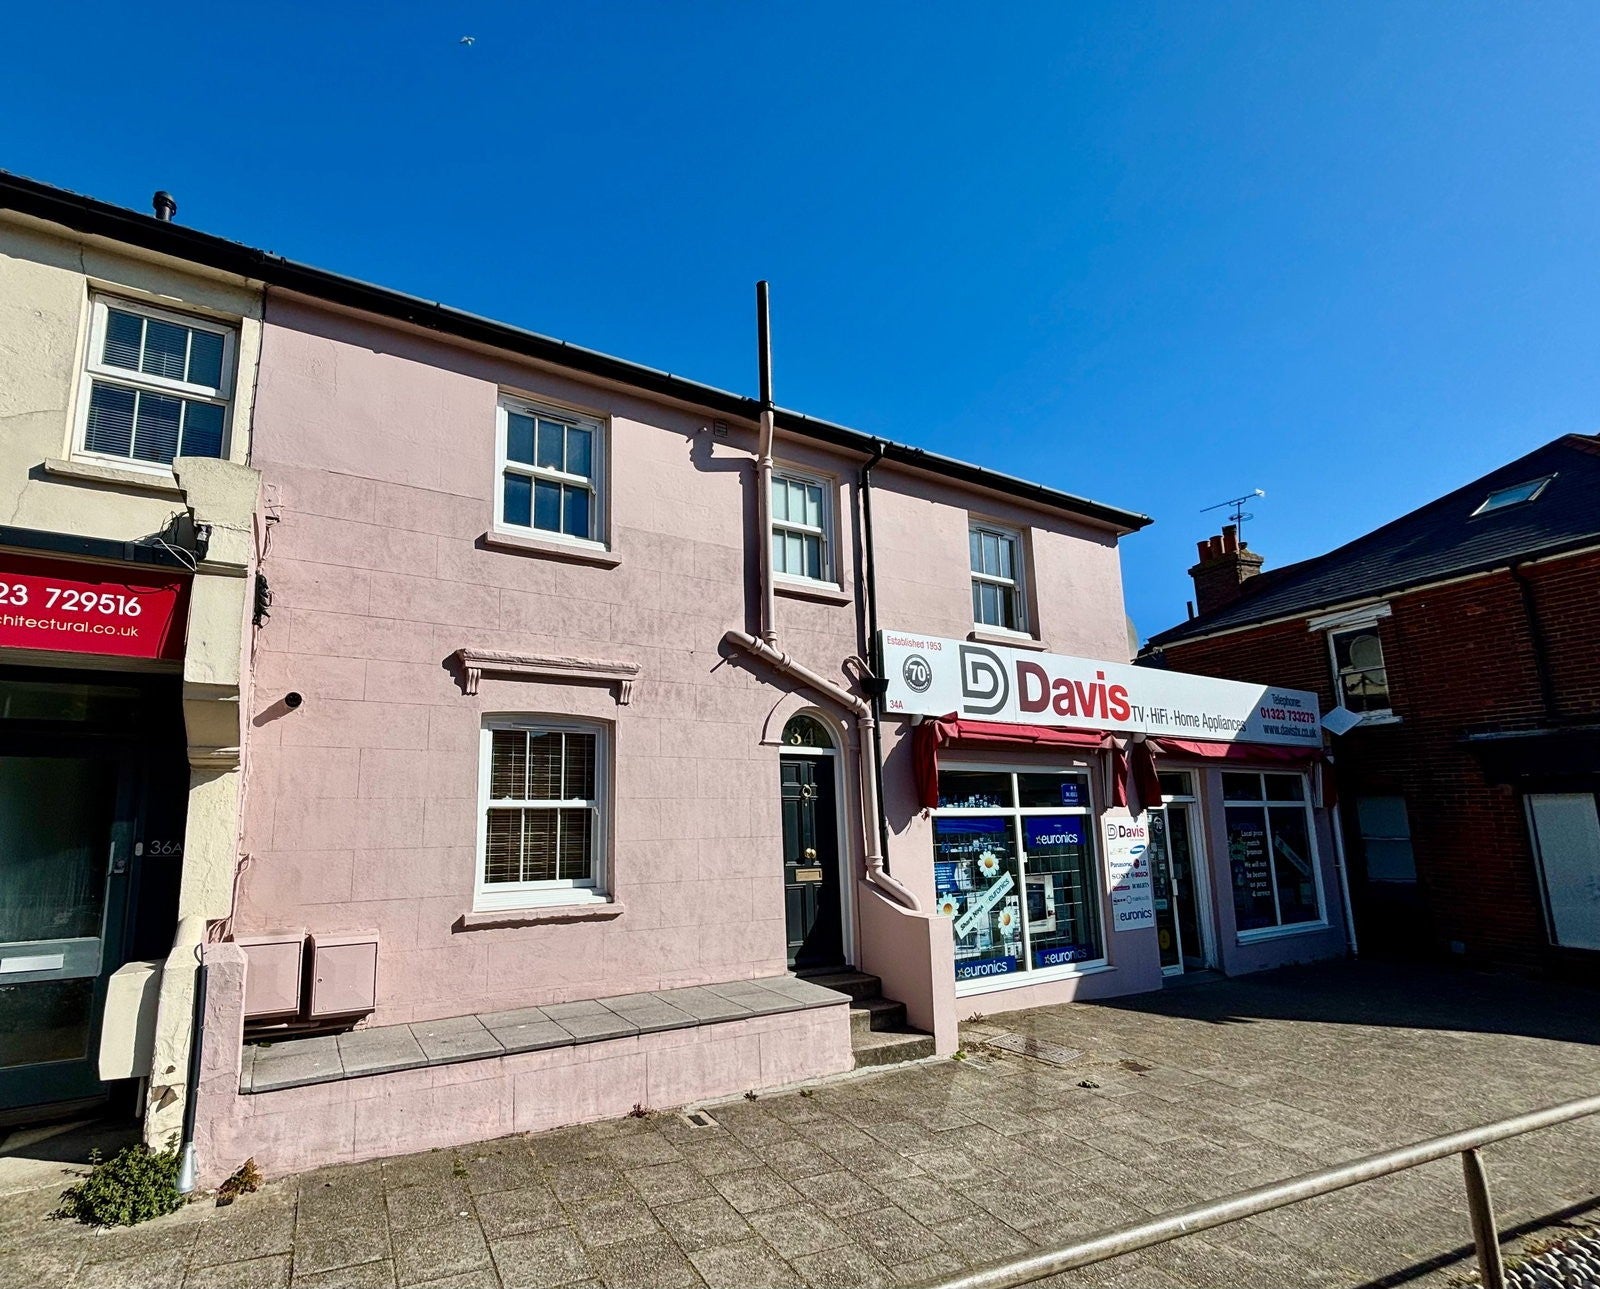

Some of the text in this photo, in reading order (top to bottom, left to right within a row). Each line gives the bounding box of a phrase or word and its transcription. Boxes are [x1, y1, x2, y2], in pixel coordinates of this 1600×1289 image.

[45, 588, 142, 617] 729516
[887, 636, 942, 651] Established 1953
[909, 664, 926, 682] 70
[1016, 660, 1130, 721] Davis
[890, 699, 904, 710] 34A
[1131, 705, 1247, 732] TV HiFi Home Appliances
[1260, 707, 1316, 724] 01323 733279
[791, 726, 815, 746] 34
[1041, 831, 1078, 844] euronics
[1118, 825, 1145, 838] Davis
[150, 840, 183, 855] 36A
[988, 878, 1010, 902] euronics
[1119, 908, 1153, 921] euronics
[1050, 949, 1087, 964] euronics
[964, 960, 1008, 977] euronics
